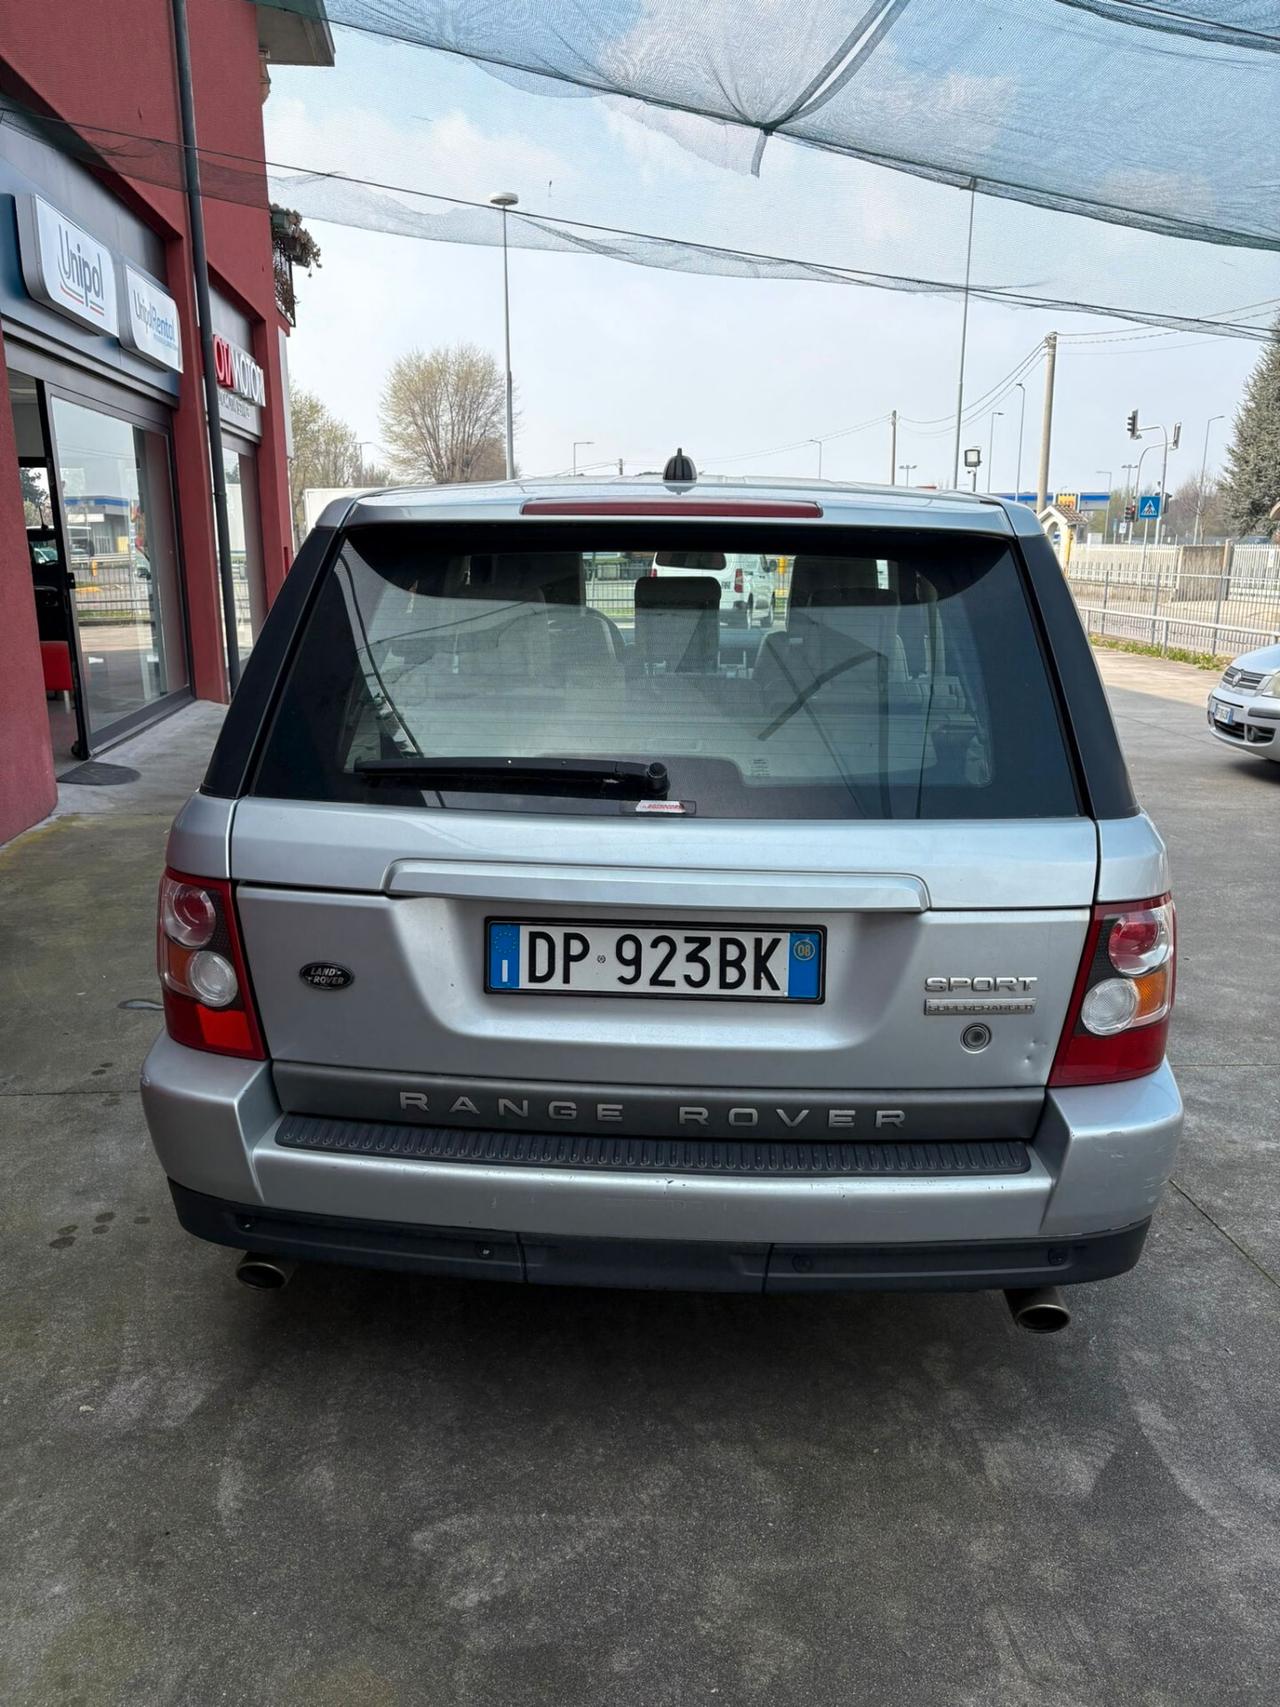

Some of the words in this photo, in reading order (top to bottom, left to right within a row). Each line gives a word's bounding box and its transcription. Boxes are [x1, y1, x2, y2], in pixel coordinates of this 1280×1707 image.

[58, 223, 104, 306] Unipol
[133, 290, 175, 342] UnipolRental
[313, 975, 345, 985] ROVER
[528, 931, 591, 985] DP
[615, 934, 783, 991] 923BK
[925, 976, 1038, 992] SPORT
[399, 1092, 624, 1122] RANGE
[678, 1106, 906, 1128] ROVER
